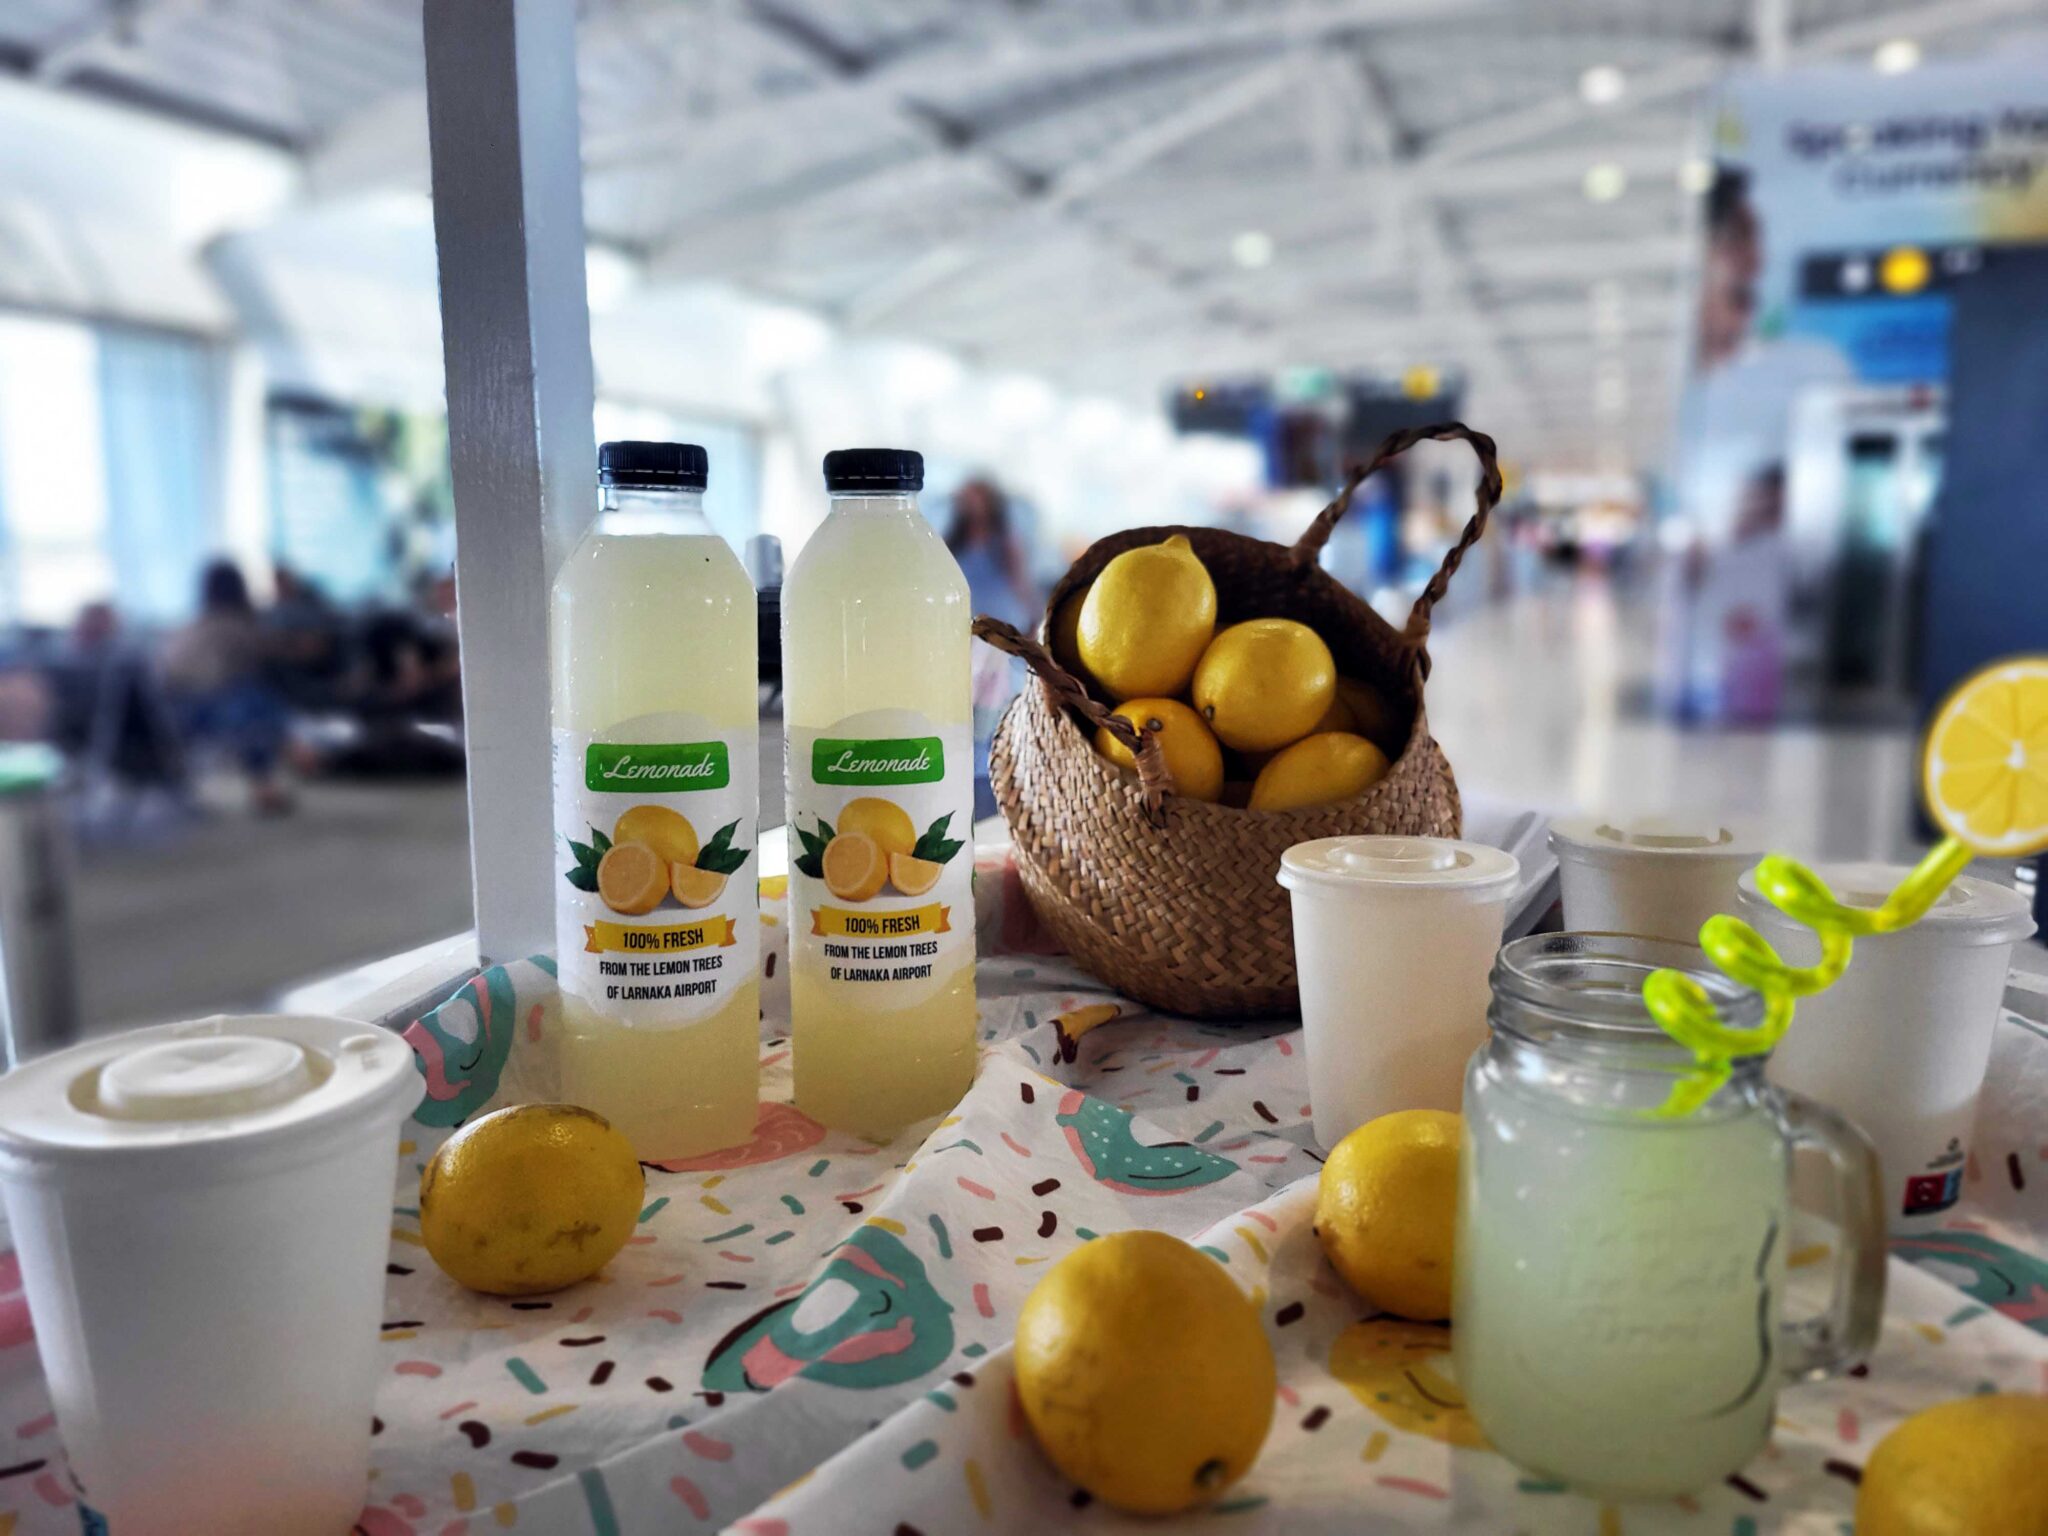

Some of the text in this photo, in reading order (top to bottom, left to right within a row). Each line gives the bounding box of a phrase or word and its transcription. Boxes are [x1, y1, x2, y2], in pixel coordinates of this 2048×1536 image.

[603, 754, 714, 779] Lemonade
[828, 748, 931, 772] Lemonade
[845, 915, 920, 934] 100% FRESH
[622, 927, 704, 949] 100% FRESH
[824, 940, 938, 959] FROM THE LEMON TREES
[600, 955, 723, 977] FROM THE LEMON TREES
[830, 963, 932, 981] OF LARNAKA AIRPORT
[606, 979, 717, 1000] OF LARNAKA AIRPORT
